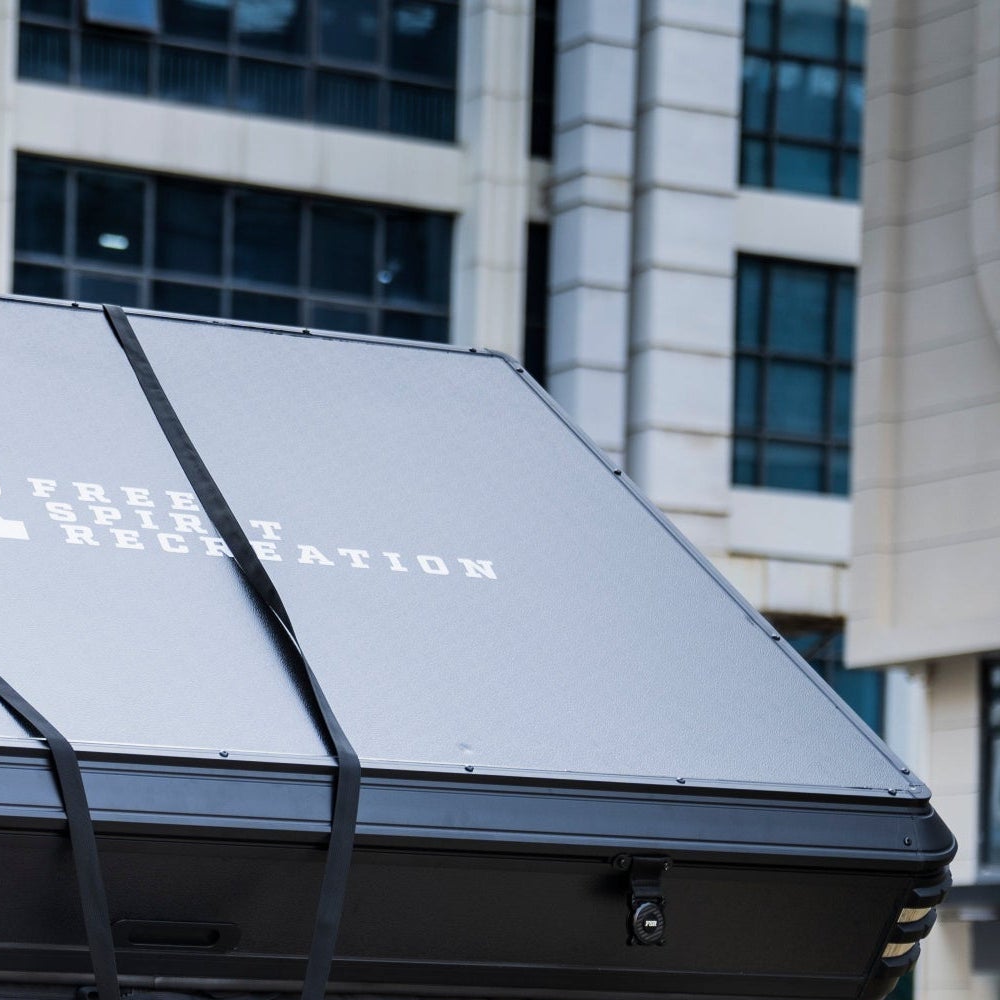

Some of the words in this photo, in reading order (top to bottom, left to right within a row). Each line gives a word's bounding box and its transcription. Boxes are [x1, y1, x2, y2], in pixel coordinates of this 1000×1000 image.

[27, 477, 200, 511] FREE
[45, 501, 282, 540] SPIRT
[61, 524, 497, 579] RECREATION
